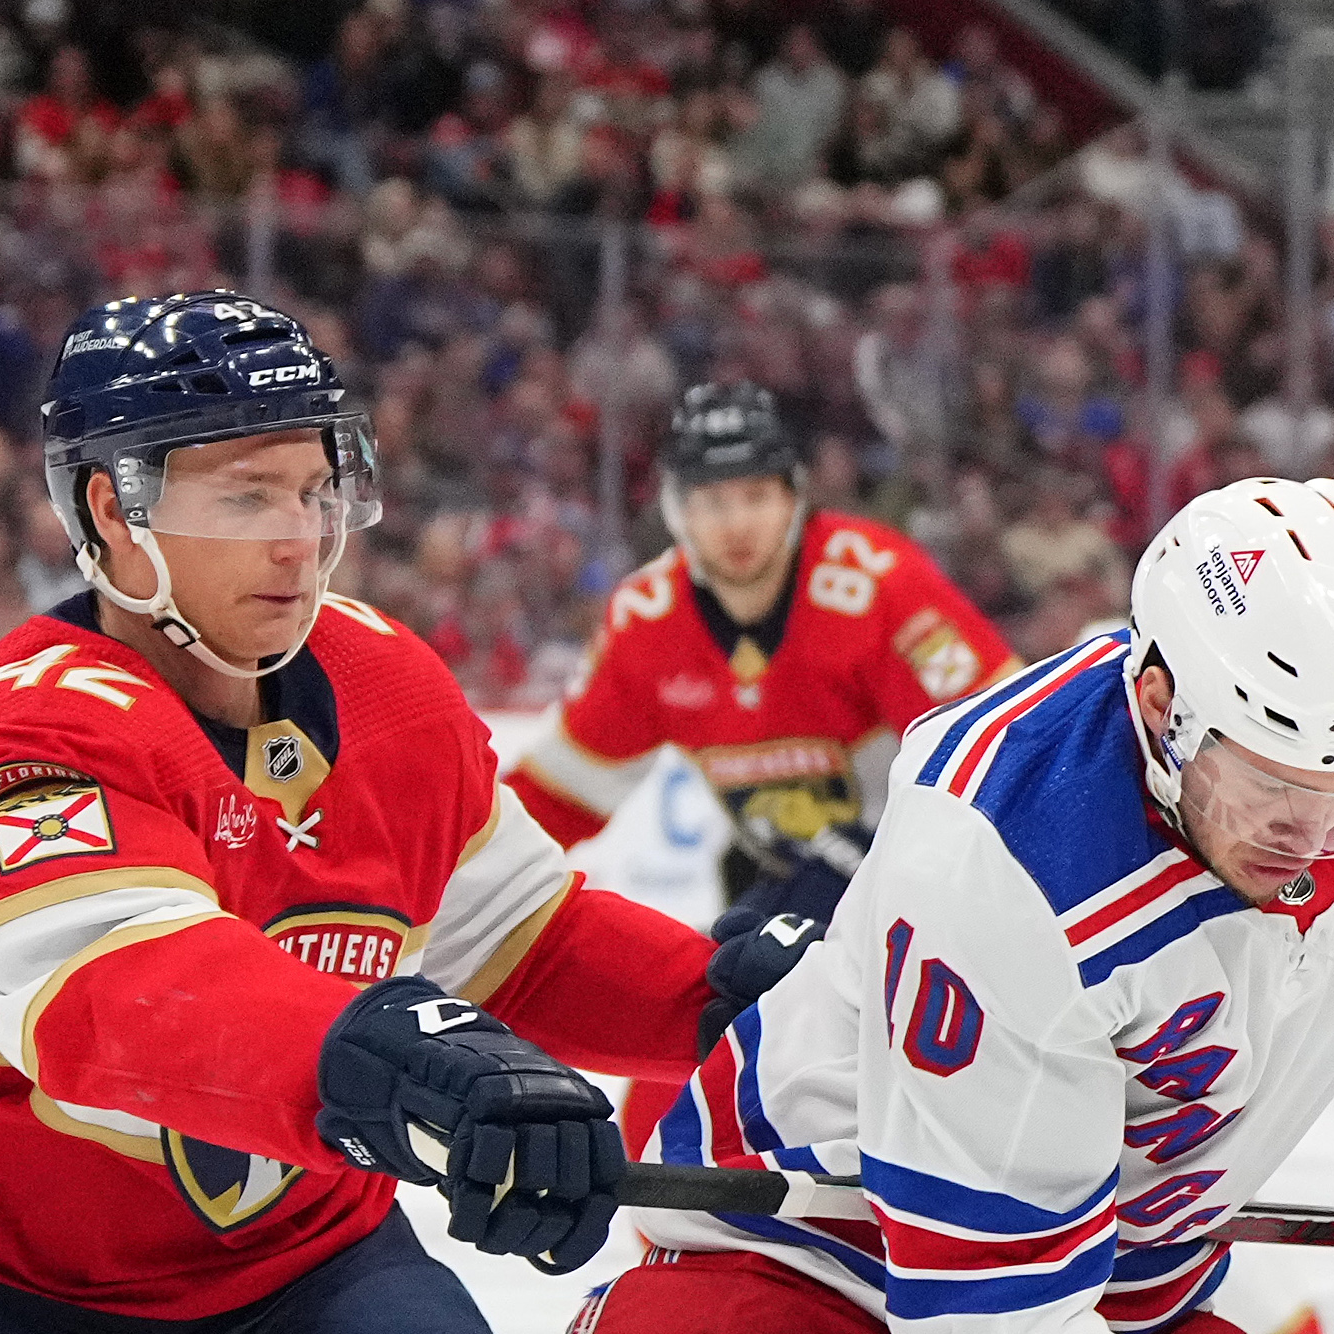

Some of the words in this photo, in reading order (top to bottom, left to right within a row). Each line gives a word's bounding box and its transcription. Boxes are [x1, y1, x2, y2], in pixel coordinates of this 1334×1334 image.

[213, 300, 280, 323] 42
[248, 361, 318, 387] CCM
[809, 530, 896, 617] 82
[1195, 560, 1227, 617] Moore
[1208, 542, 1247, 617] Benjamin
[886, 917, 984, 1078] 10
